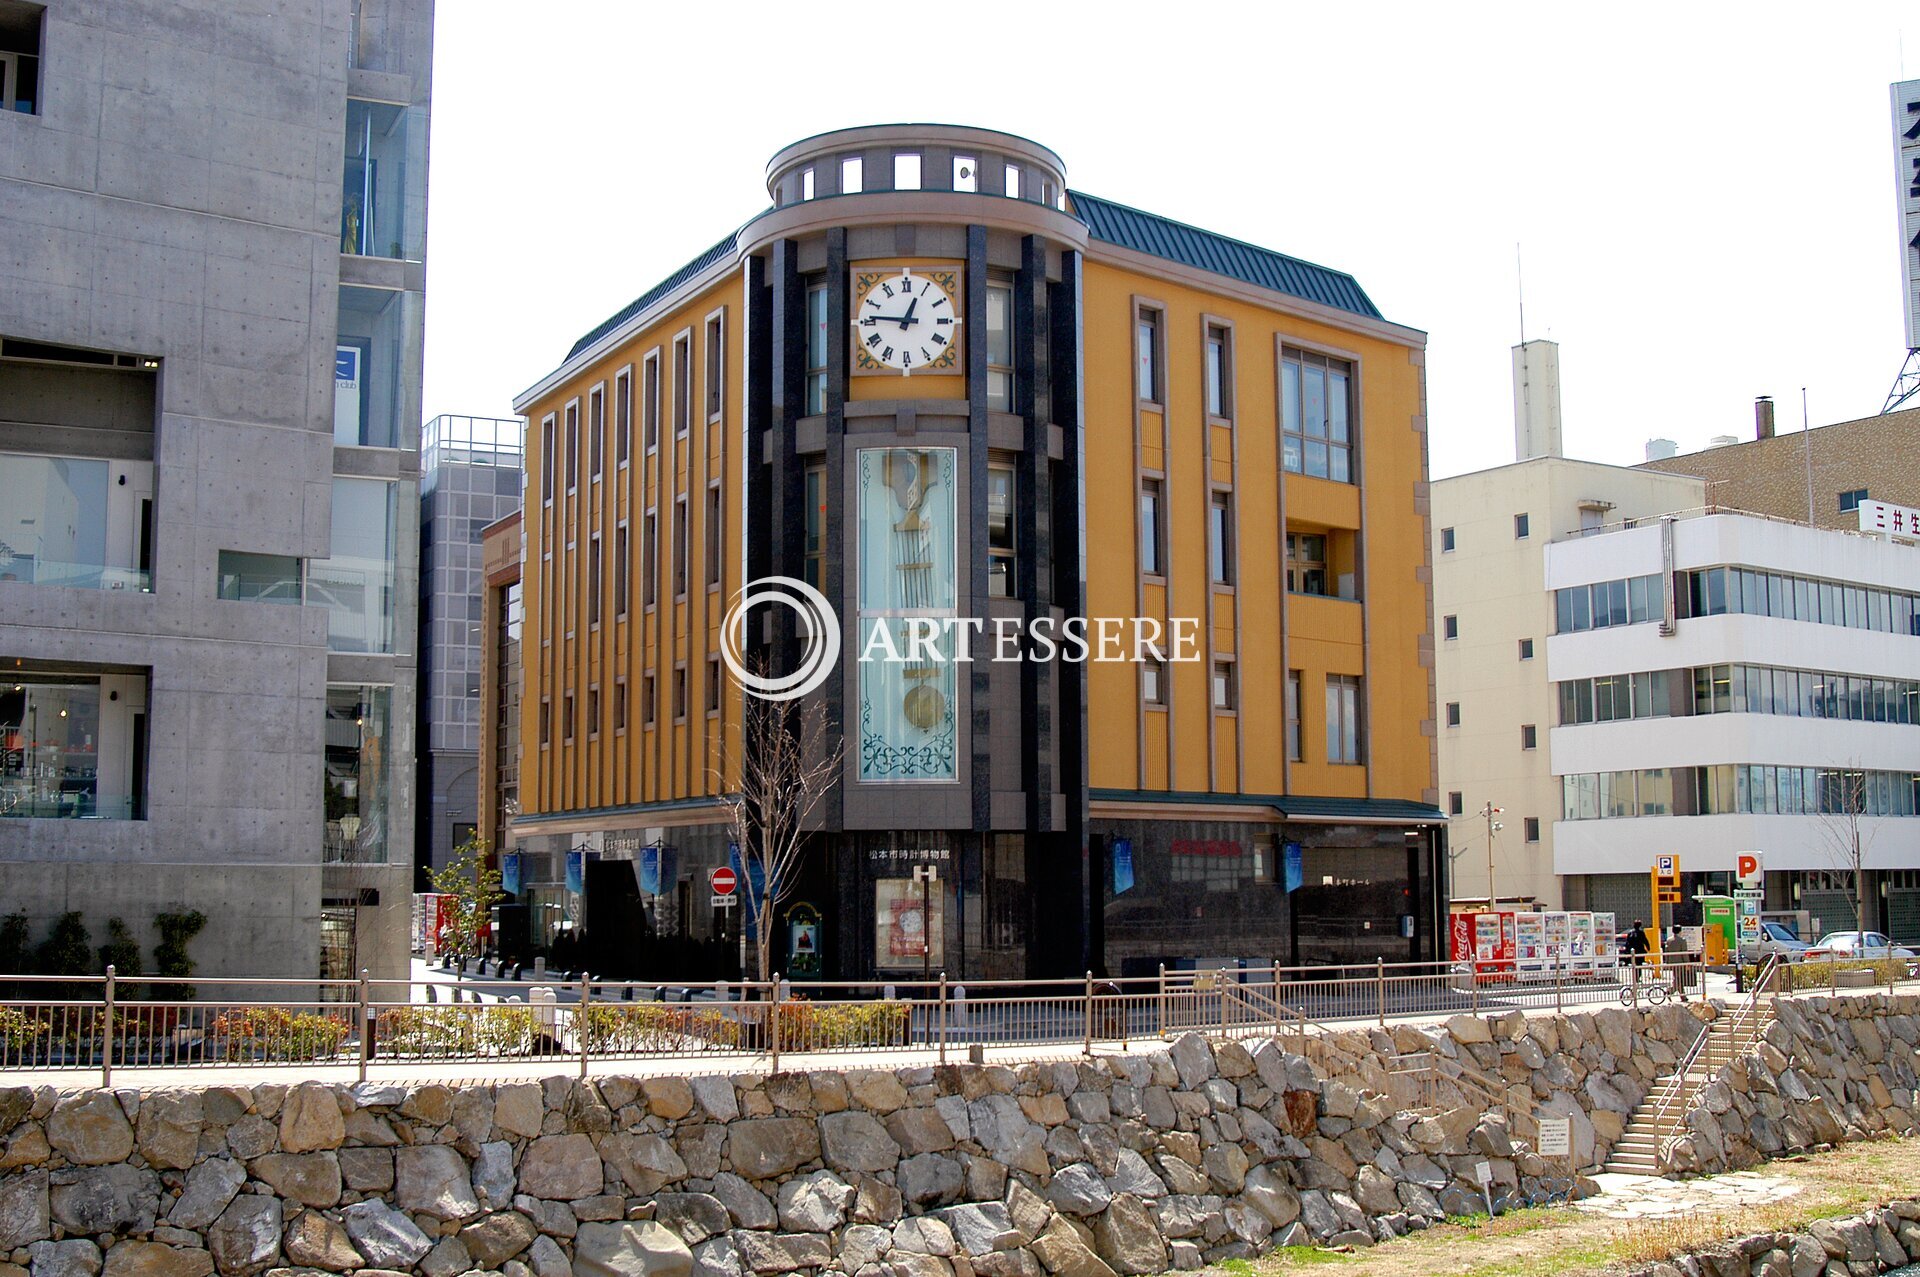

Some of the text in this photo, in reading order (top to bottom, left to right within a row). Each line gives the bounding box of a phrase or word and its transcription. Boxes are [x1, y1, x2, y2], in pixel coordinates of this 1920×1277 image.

[869, 849, 950, 860] 松本市時計博物館
[1661, 858, 1671, 868] P
[1738, 855, 1757, 878] P
[1743, 917, 1757, 927] 24
